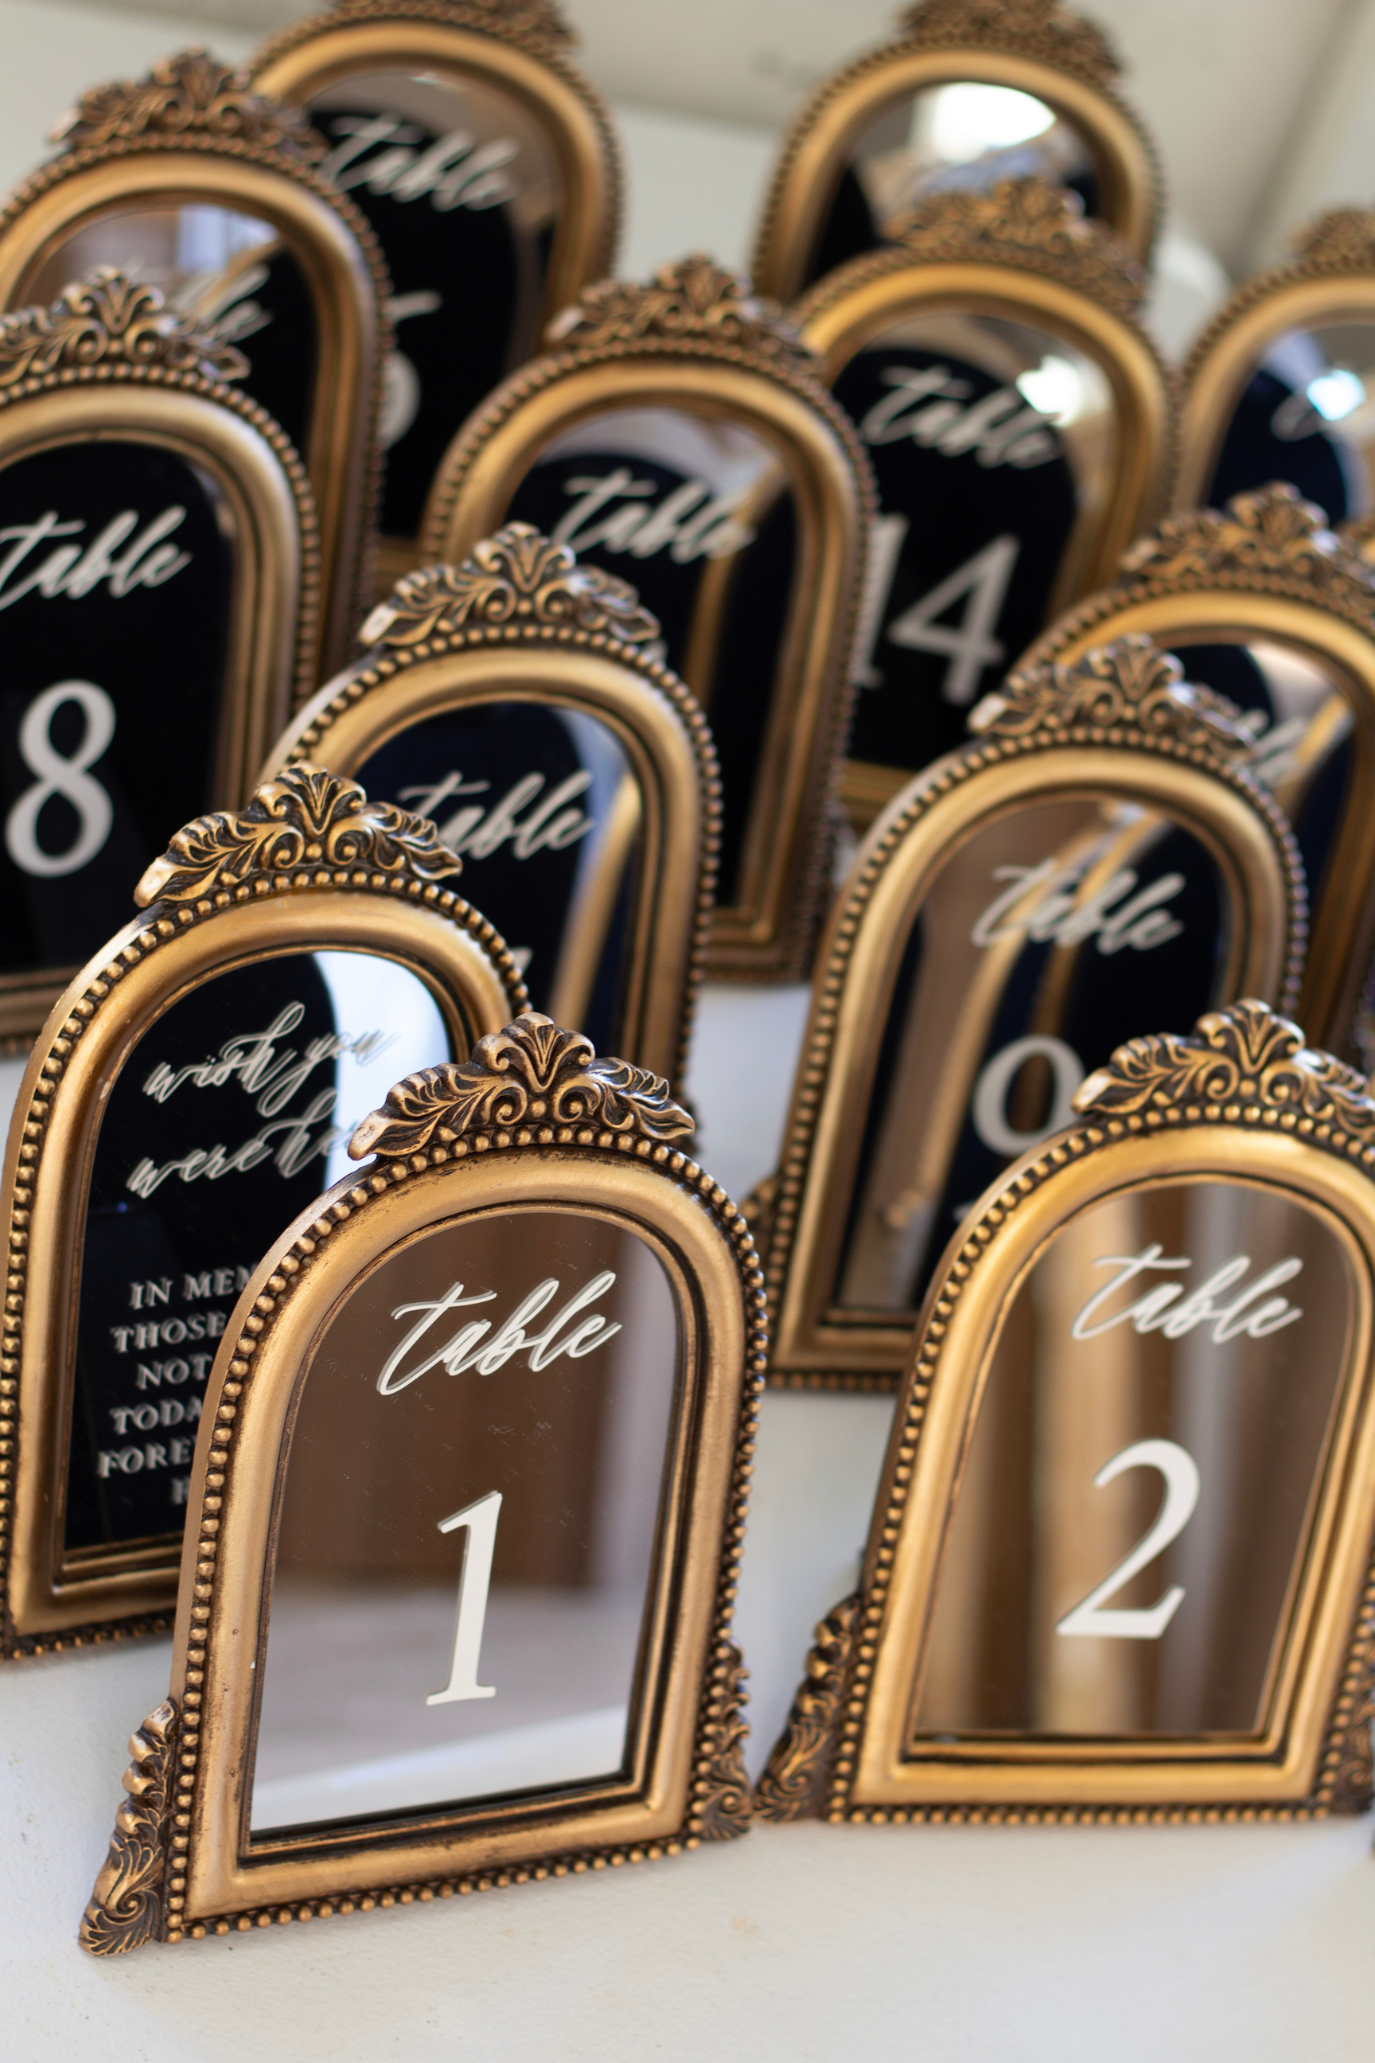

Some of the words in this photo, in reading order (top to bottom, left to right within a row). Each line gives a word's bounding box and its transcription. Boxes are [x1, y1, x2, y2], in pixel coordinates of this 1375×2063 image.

[0, 506, 193, 611] table
[550, 466, 758, 566] table
[847, 513, 1020, 704] 14
[5, 679, 117, 878] 8
[970, 857, 1186, 955] table
[143, 1001, 305, 1104] wish
[257, 1031, 400, 1118] you
[127, 1143, 273, 1199] were
[109, 1309, 227, 1354] THOSE
[129, 1277, 173, 1311] IN
[376, 1270, 623, 1396] table
[1071, 1244, 1303, 1344] table
[109, 1395, 202, 1436] TODA
[135, 1352, 213, 1391] NOT
[97, 1435, 197, 1479] FORE
[1056, 1438, 1200, 1640] 2
[426, 1490, 502, 1706] 1
